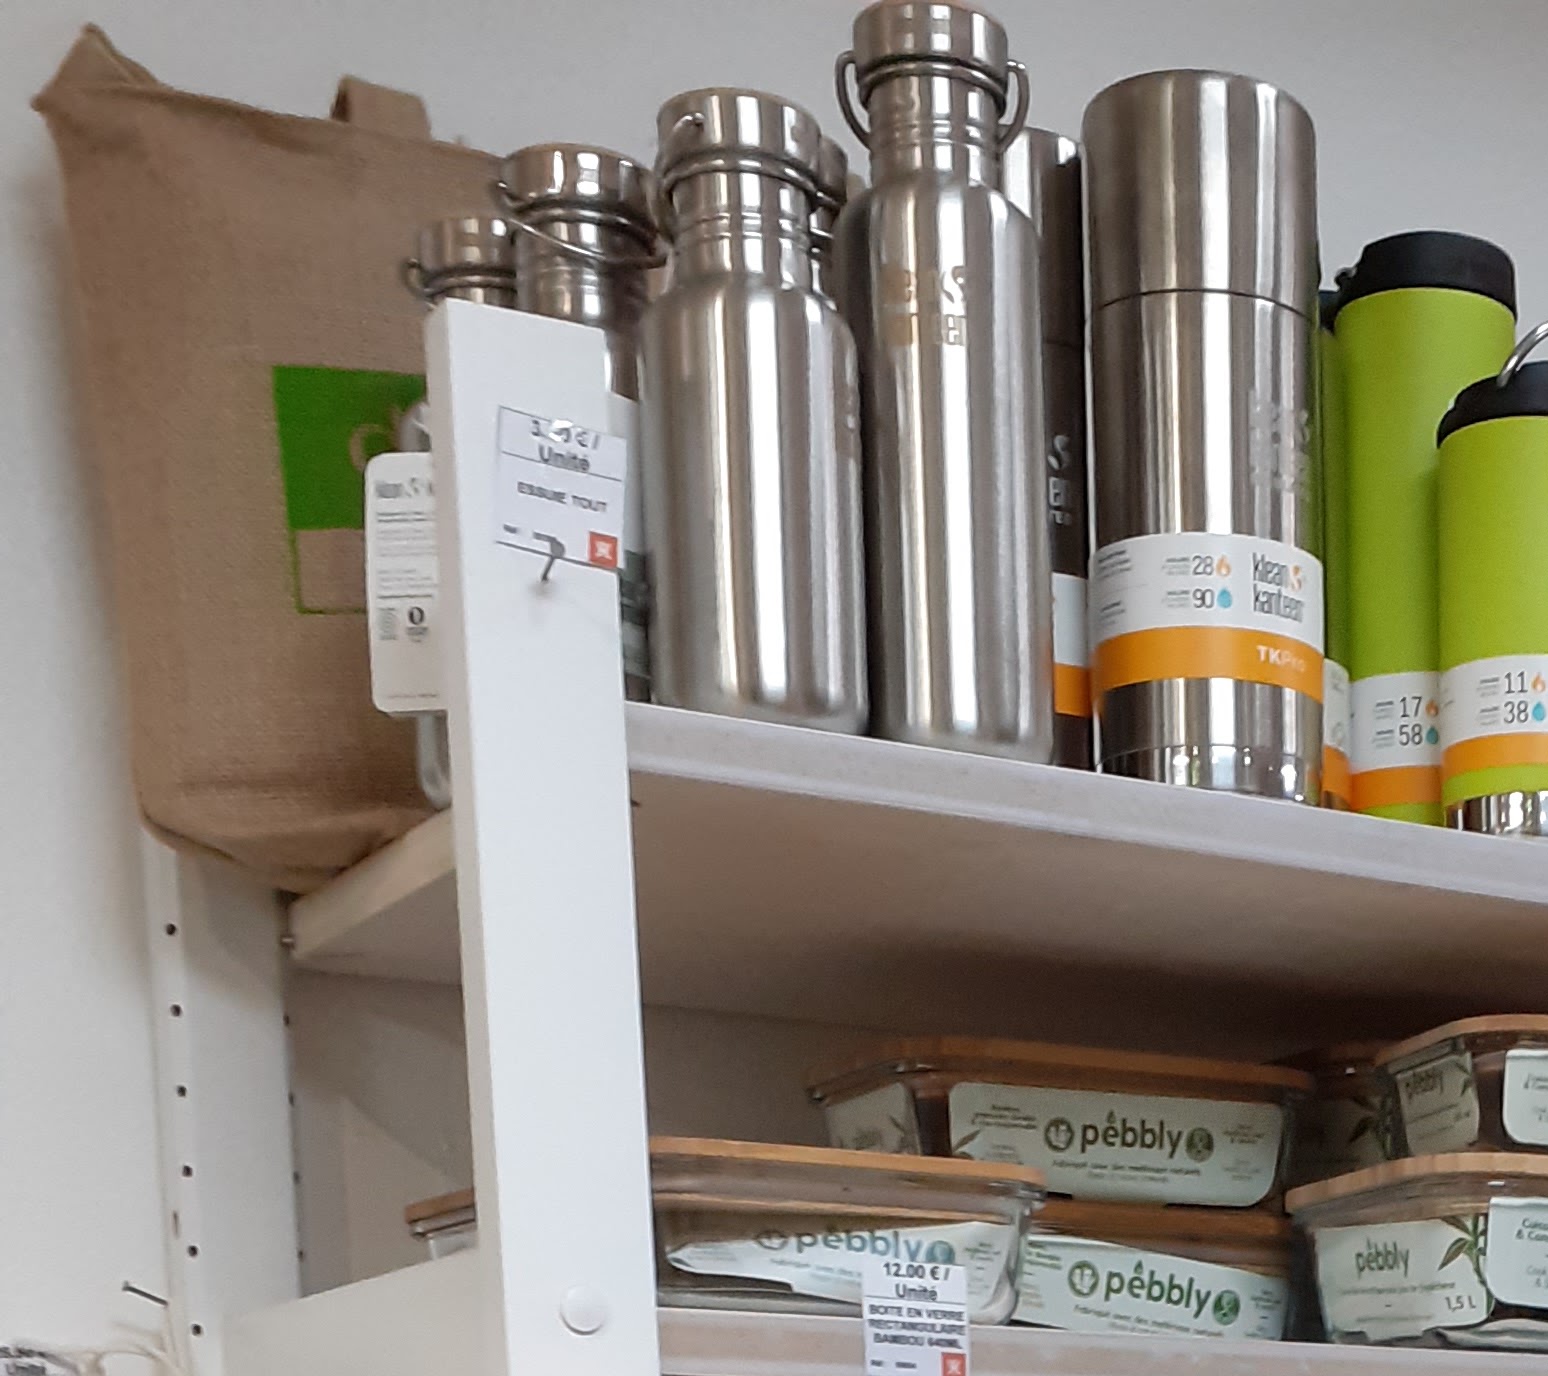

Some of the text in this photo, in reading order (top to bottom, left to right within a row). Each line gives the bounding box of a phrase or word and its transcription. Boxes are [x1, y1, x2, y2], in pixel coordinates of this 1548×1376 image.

[1192, 556, 1214, 576] 28
[1192, 589, 1215, 608] 90
[1504, 671, 1528, 694] 11
[1400, 696, 1422, 718] 17
[1503, 701, 1529, 724] 38
[1399, 724, 1422, 746] 58
[883, 1262, 926, 1280] 12.00
[895, 1283, 938, 1301] Unité
